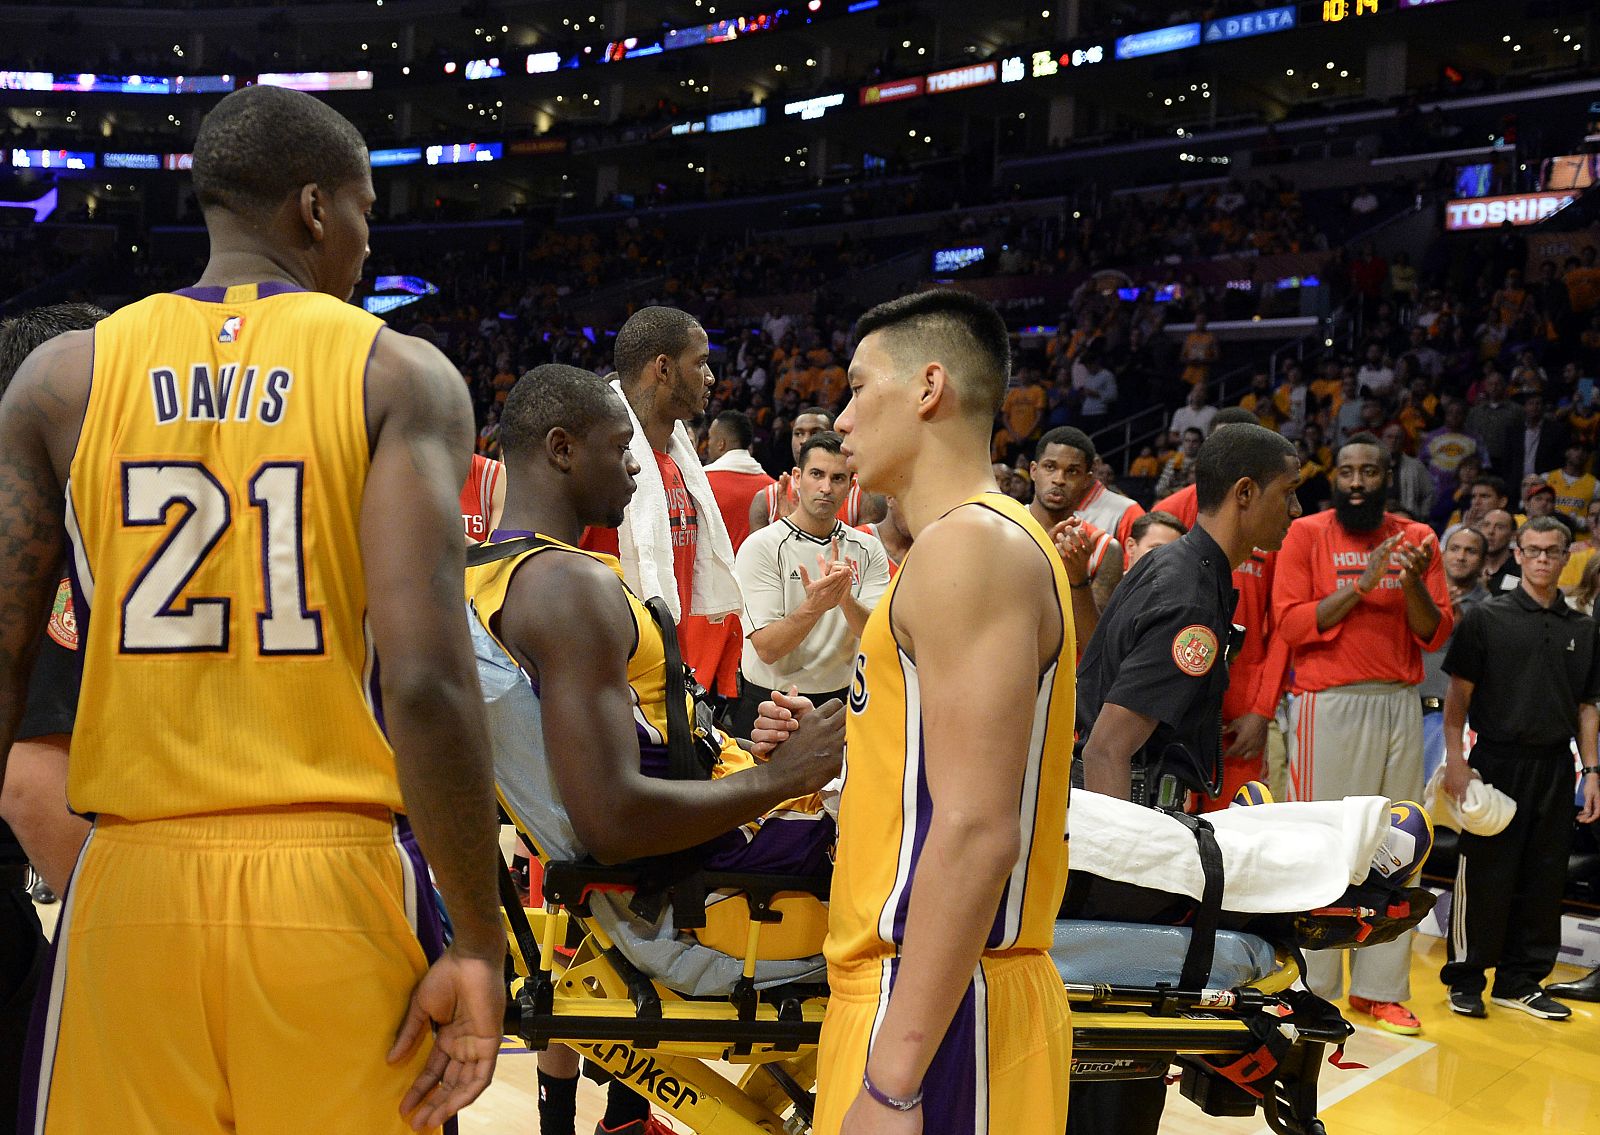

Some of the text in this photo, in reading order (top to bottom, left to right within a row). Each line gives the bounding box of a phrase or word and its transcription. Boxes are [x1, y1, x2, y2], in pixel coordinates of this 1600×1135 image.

[1225, 10, 1294, 36] DELTA
[926, 64, 996, 92] TOSHIBA
[1450, 196, 1572, 226] TOSHIB
[150, 362, 294, 427] DAVIS
[118, 458, 326, 656] 21
